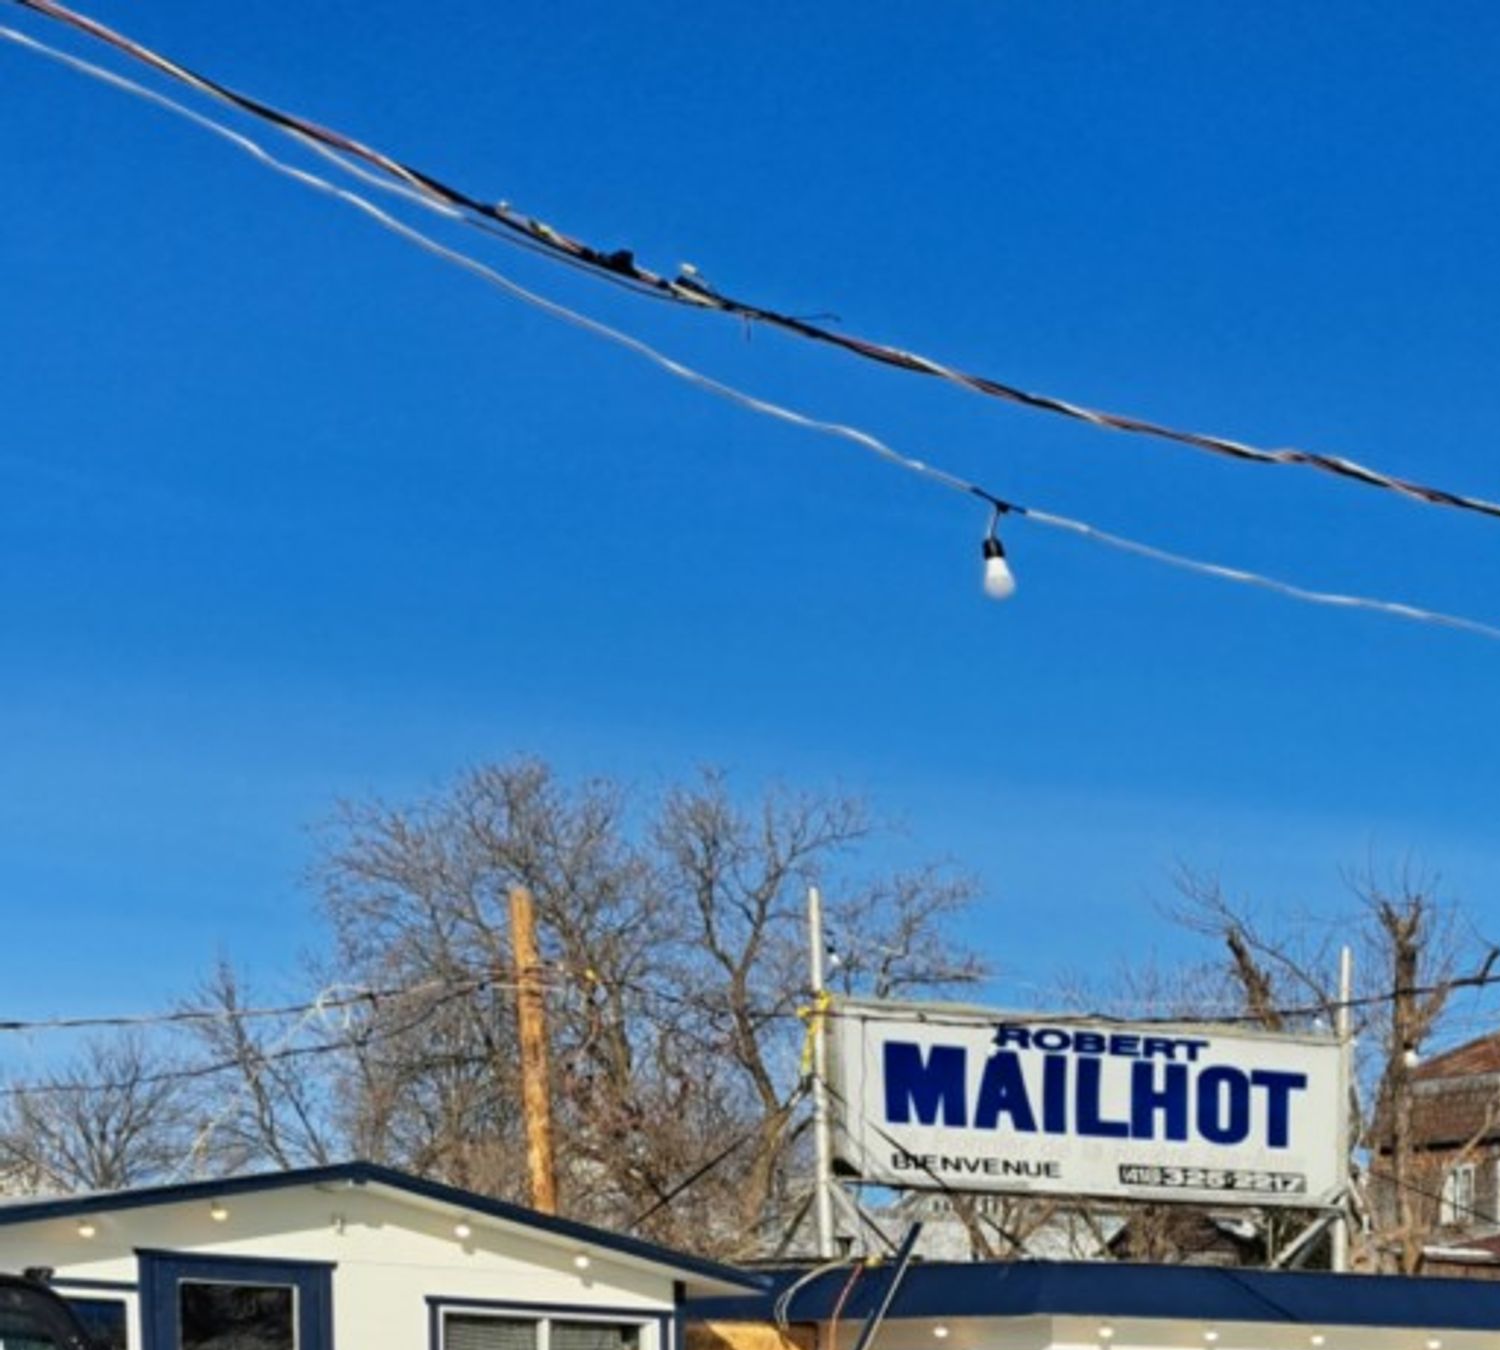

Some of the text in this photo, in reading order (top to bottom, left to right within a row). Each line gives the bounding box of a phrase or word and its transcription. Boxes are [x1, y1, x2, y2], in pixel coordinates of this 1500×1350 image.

[993, 1024, 1210, 1061] ROBERT
[883, 1041, 1307, 1148] MAILHOT
[891, 1153, 1062, 1178] BIENVENUE
